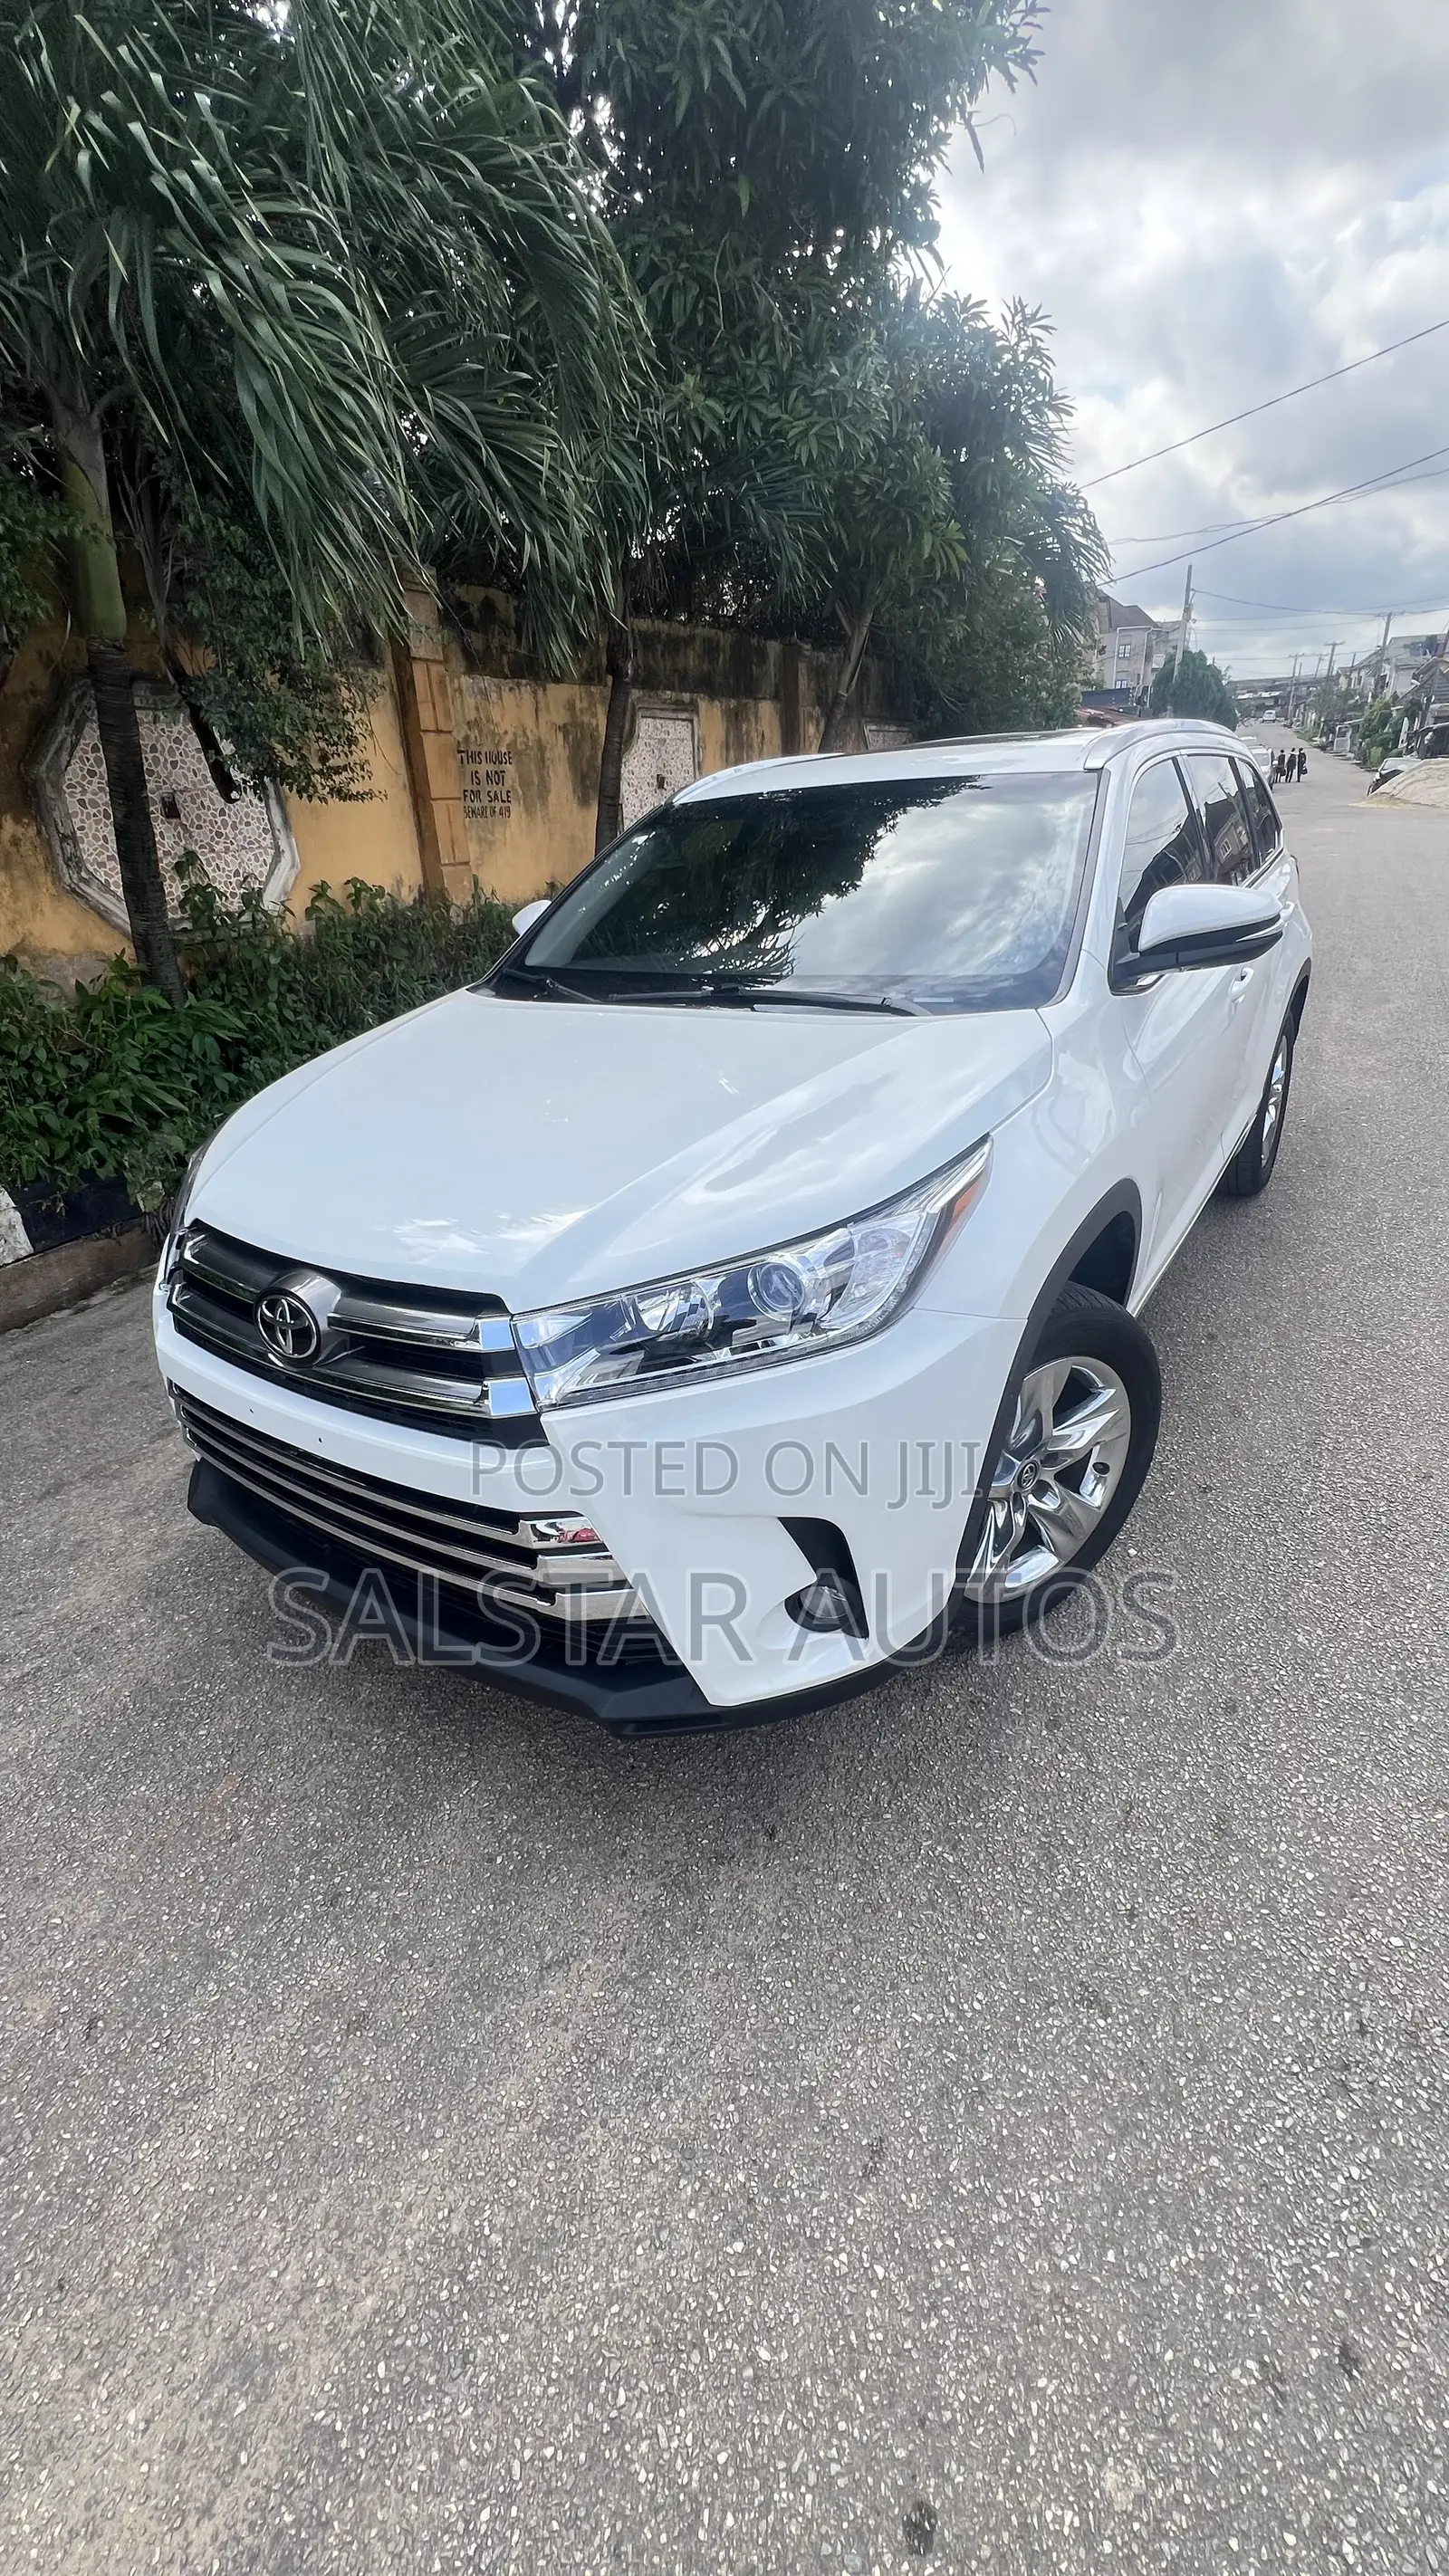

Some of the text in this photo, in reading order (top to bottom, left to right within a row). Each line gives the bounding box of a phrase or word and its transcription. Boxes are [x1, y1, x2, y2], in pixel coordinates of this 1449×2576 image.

[456, 749, 513, 765] THIS HOUSE
[470, 770, 506, 786] IS NOT
[463, 789, 513, 803] FOR SALE
[463, 805, 512, 819] BEWARE OF 419
